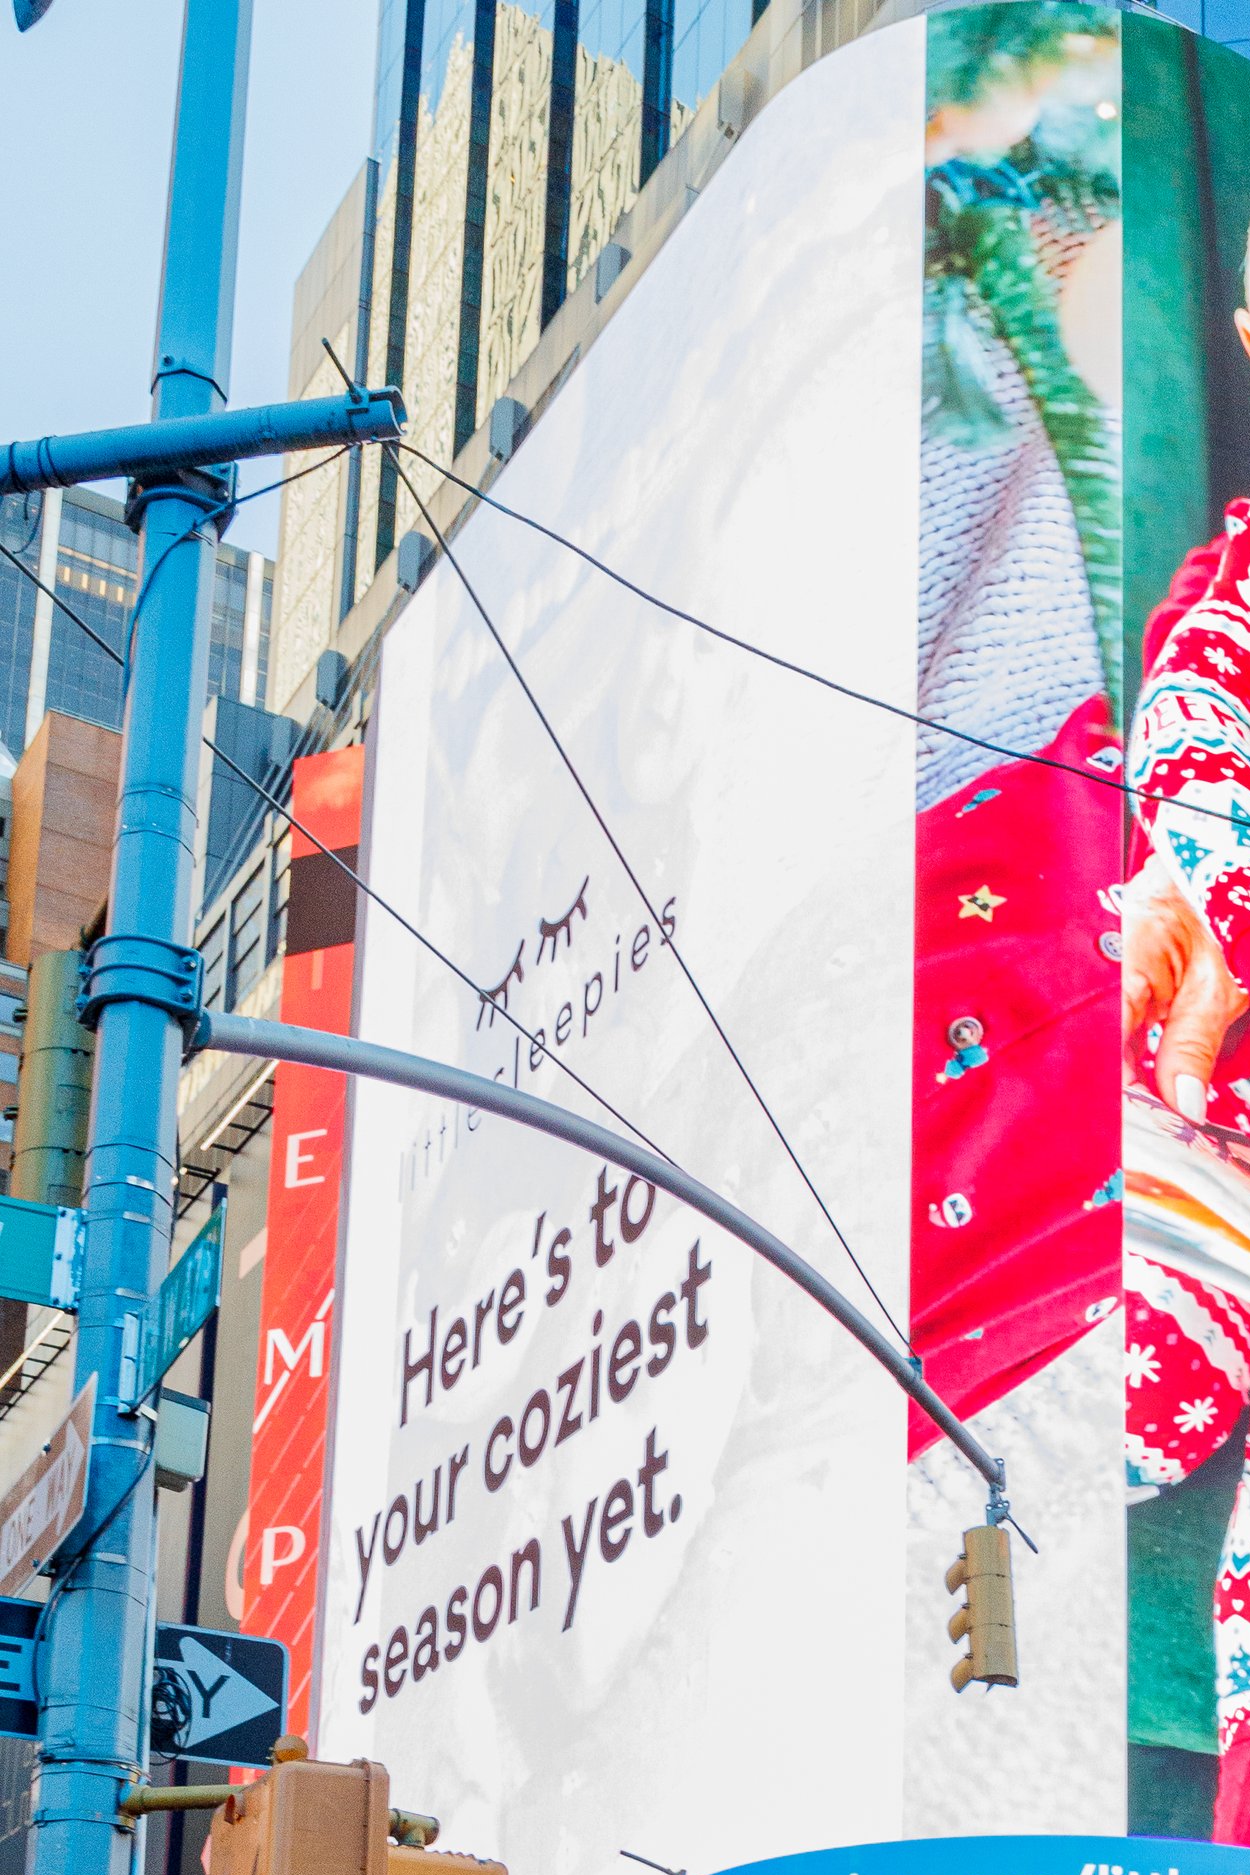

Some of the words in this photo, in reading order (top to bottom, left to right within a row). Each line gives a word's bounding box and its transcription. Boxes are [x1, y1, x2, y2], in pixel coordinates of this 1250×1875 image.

[354, 1444, 469, 1626] your
[484, 1236, 713, 1494] coziest
[400, 1210, 572, 1428] Here's
[590, 1163, 657, 1268] to
[358, 1537, 541, 1715] season
[561, 1425, 683, 1633] yet.
